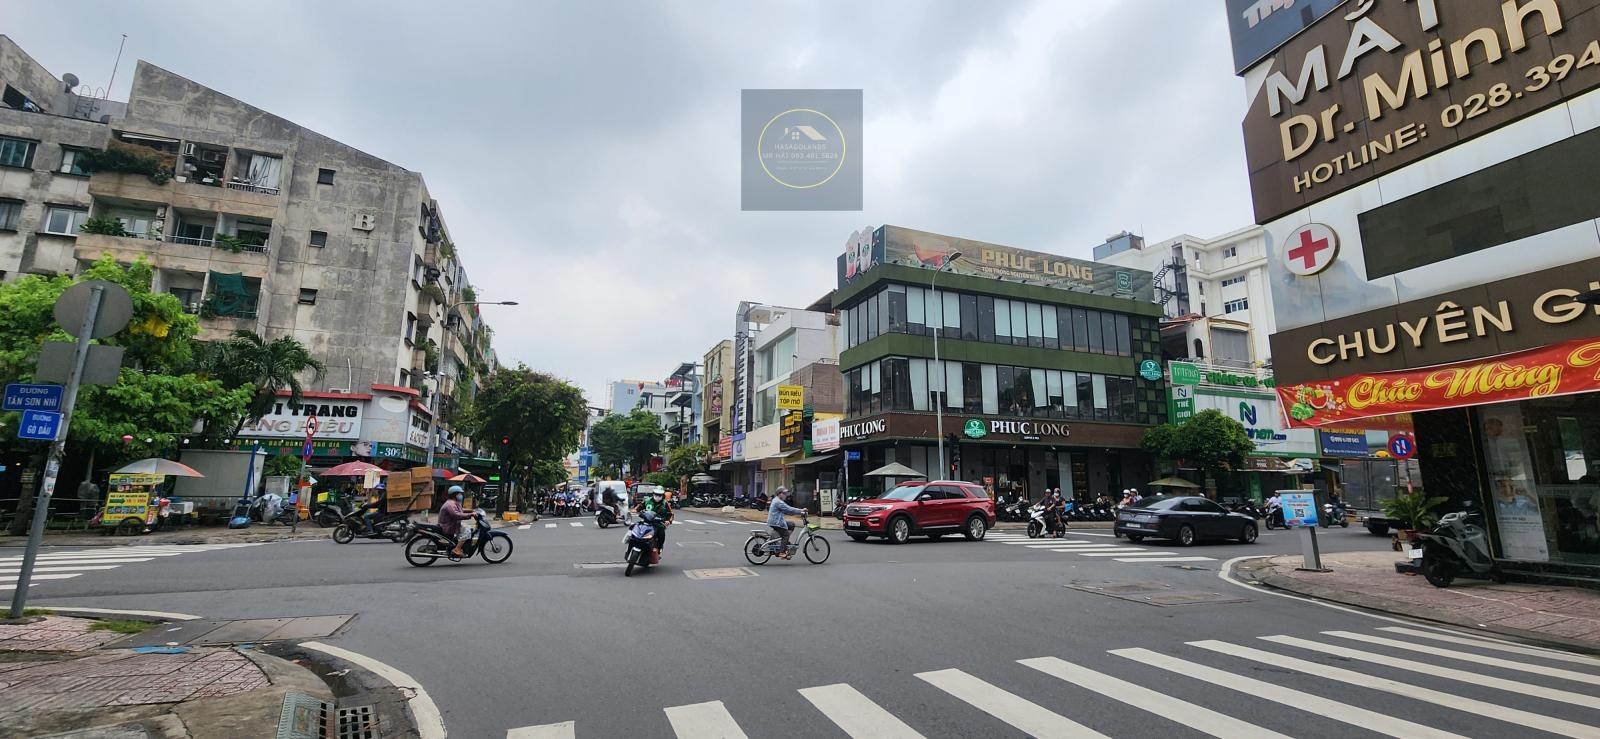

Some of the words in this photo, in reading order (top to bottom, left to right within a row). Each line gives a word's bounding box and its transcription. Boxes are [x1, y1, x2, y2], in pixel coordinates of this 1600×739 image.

[1280, 103, 1356, 162] Dr.
[1362, 0, 1563, 121] Minh
[1293, 122, 1428, 193] HOTLINE:
[353, 211, 375, 230] B
[1044, 259, 1093, 281] LONG
[1307, 300, 1513, 365] CHUYÊN
[1347, 375, 1422, 410] Chúc
[1424, 361, 1564, 399] Mừng
[288, 403, 358, 417] TRANG
[861, 418, 885, 436] LONG
[1034, 422, 1070, 437] LONG
